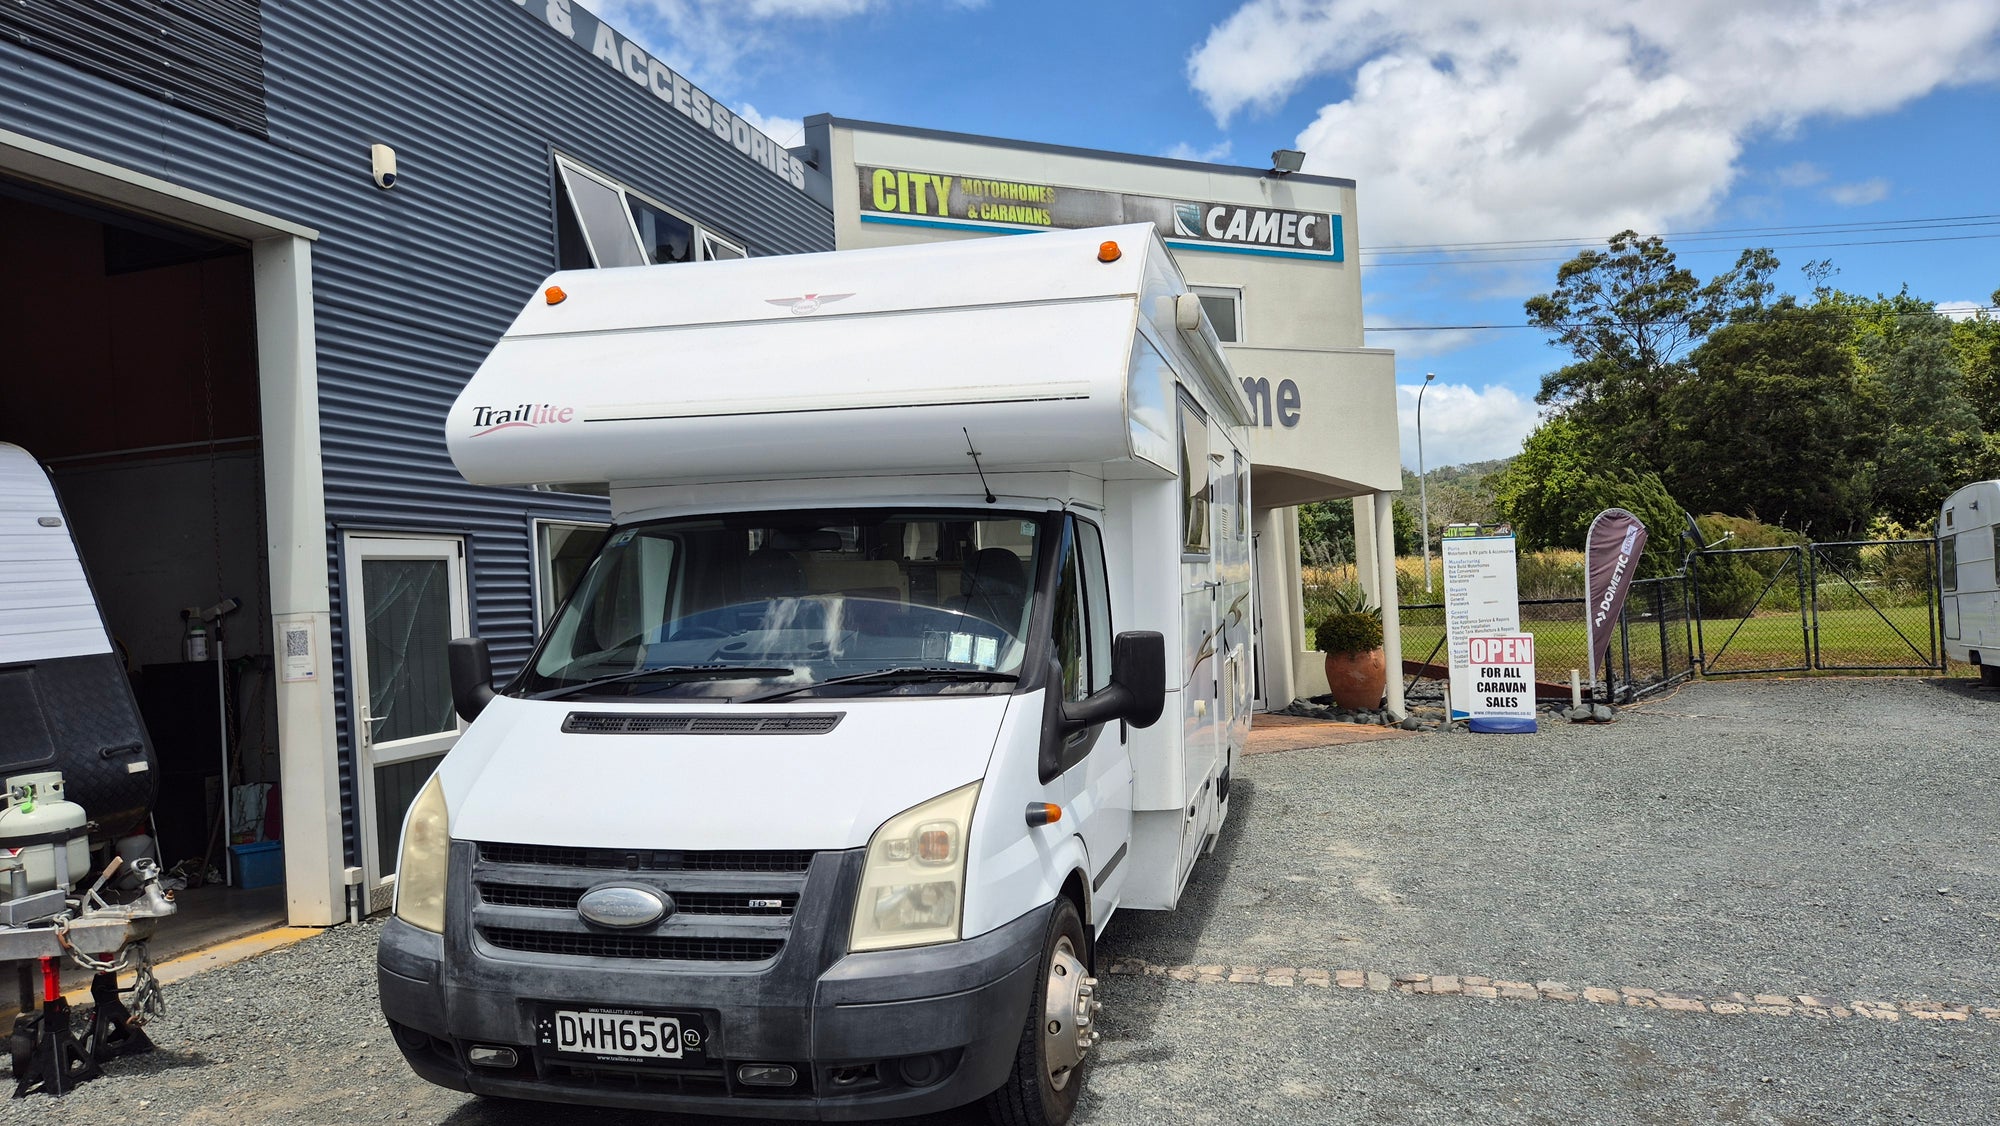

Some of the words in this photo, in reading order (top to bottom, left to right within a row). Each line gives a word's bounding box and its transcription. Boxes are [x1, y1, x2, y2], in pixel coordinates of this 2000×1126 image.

[546, 0, 575, 39] &
[593, 23, 805, 190] ACCESSORIES
[872, 168, 952, 216] CITY
[961, 178, 1055, 204] MOTORHOMES
[968, 203, 978, 219] &
[980, 203, 1051, 226] CARAVANS
[1206, 206, 1315, 247] CAMEC
[473, 404, 574, 427] Traillite
[1600, 554, 1629, 612] DOMETIC
[1471, 639, 1531, 663] OPEN
[1481, 667, 1501, 678] FOR
[1504, 667, 1521, 678] ALL
[1477, 682, 1527, 693] CARAVAN
[1486, 697, 1518, 708] SALES
[559, 1015, 679, 1053] DWH650
